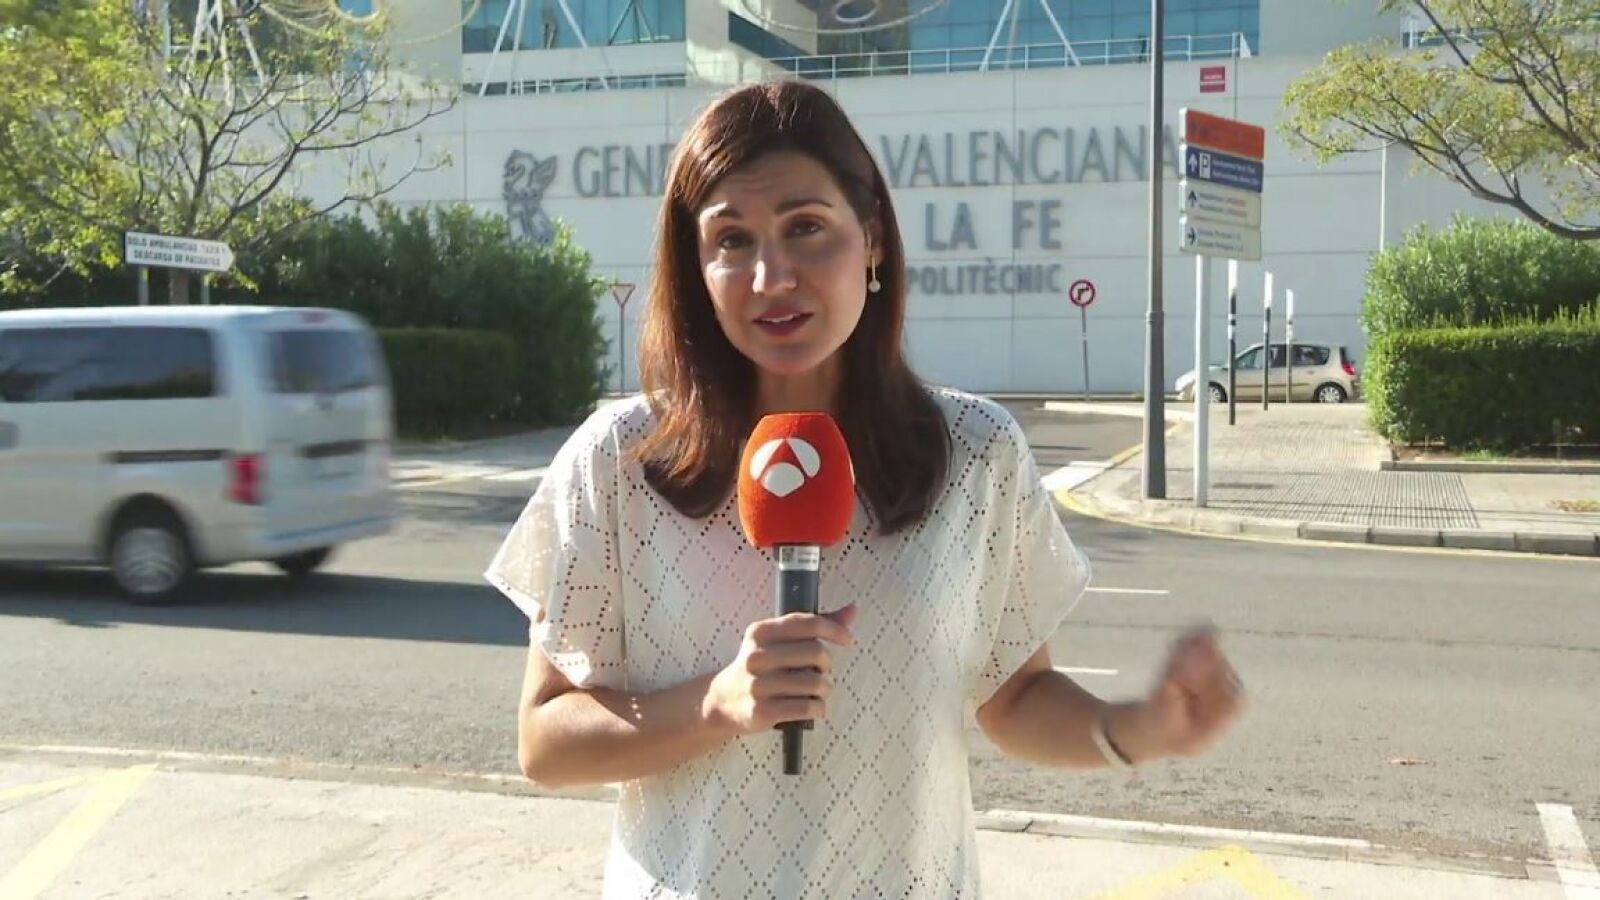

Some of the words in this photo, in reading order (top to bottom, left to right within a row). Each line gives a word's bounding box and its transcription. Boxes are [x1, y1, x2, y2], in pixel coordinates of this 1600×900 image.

[880, 124, 1180, 189] VALENCIANA
[925, 202, 978, 250] LA
[1012, 200, 1062, 250] FE
[133, 249, 173, 262] DESCARGA
[174, 253, 183, 263] DE
[907, 257, 1062, 295] POLITÈCNIC
